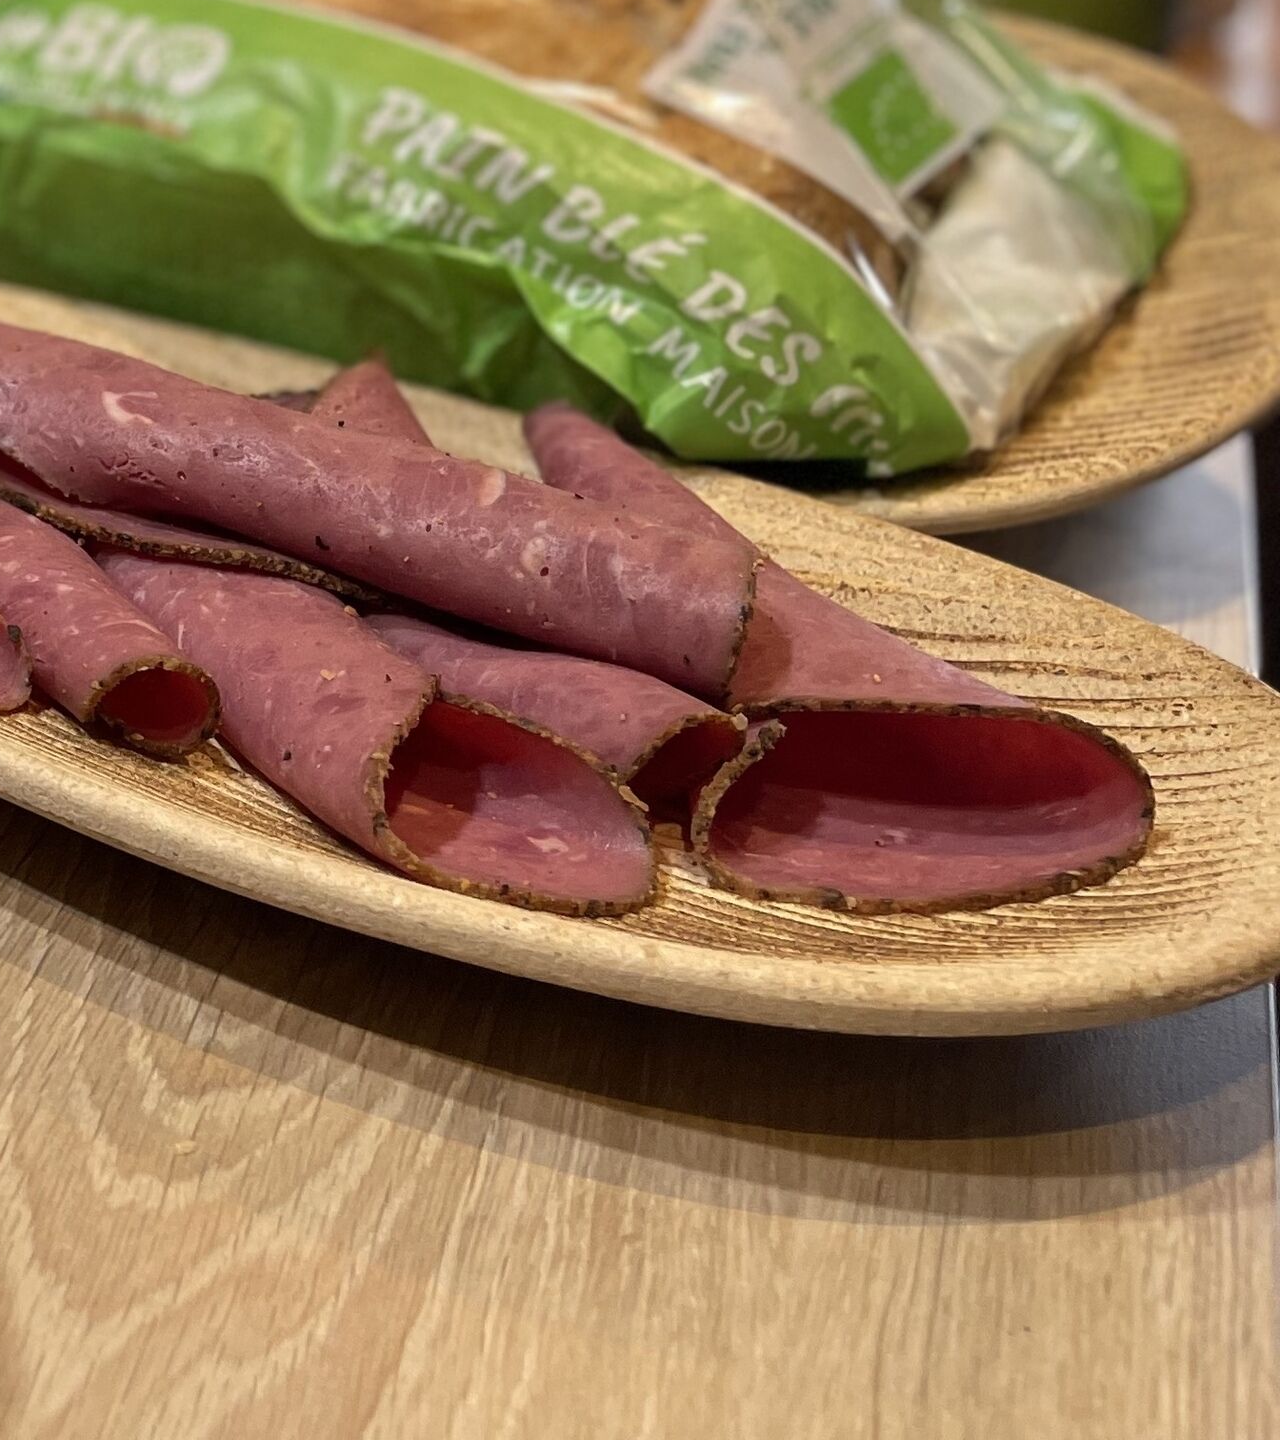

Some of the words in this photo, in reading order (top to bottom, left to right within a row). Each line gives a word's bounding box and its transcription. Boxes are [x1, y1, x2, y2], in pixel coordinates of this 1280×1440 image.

[326, 157, 638, 326] FABRICATION
[649, 327, 817, 460] MAISON
[362, 87, 549, 206] PAIN
[680, 269, 823, 385] DES
